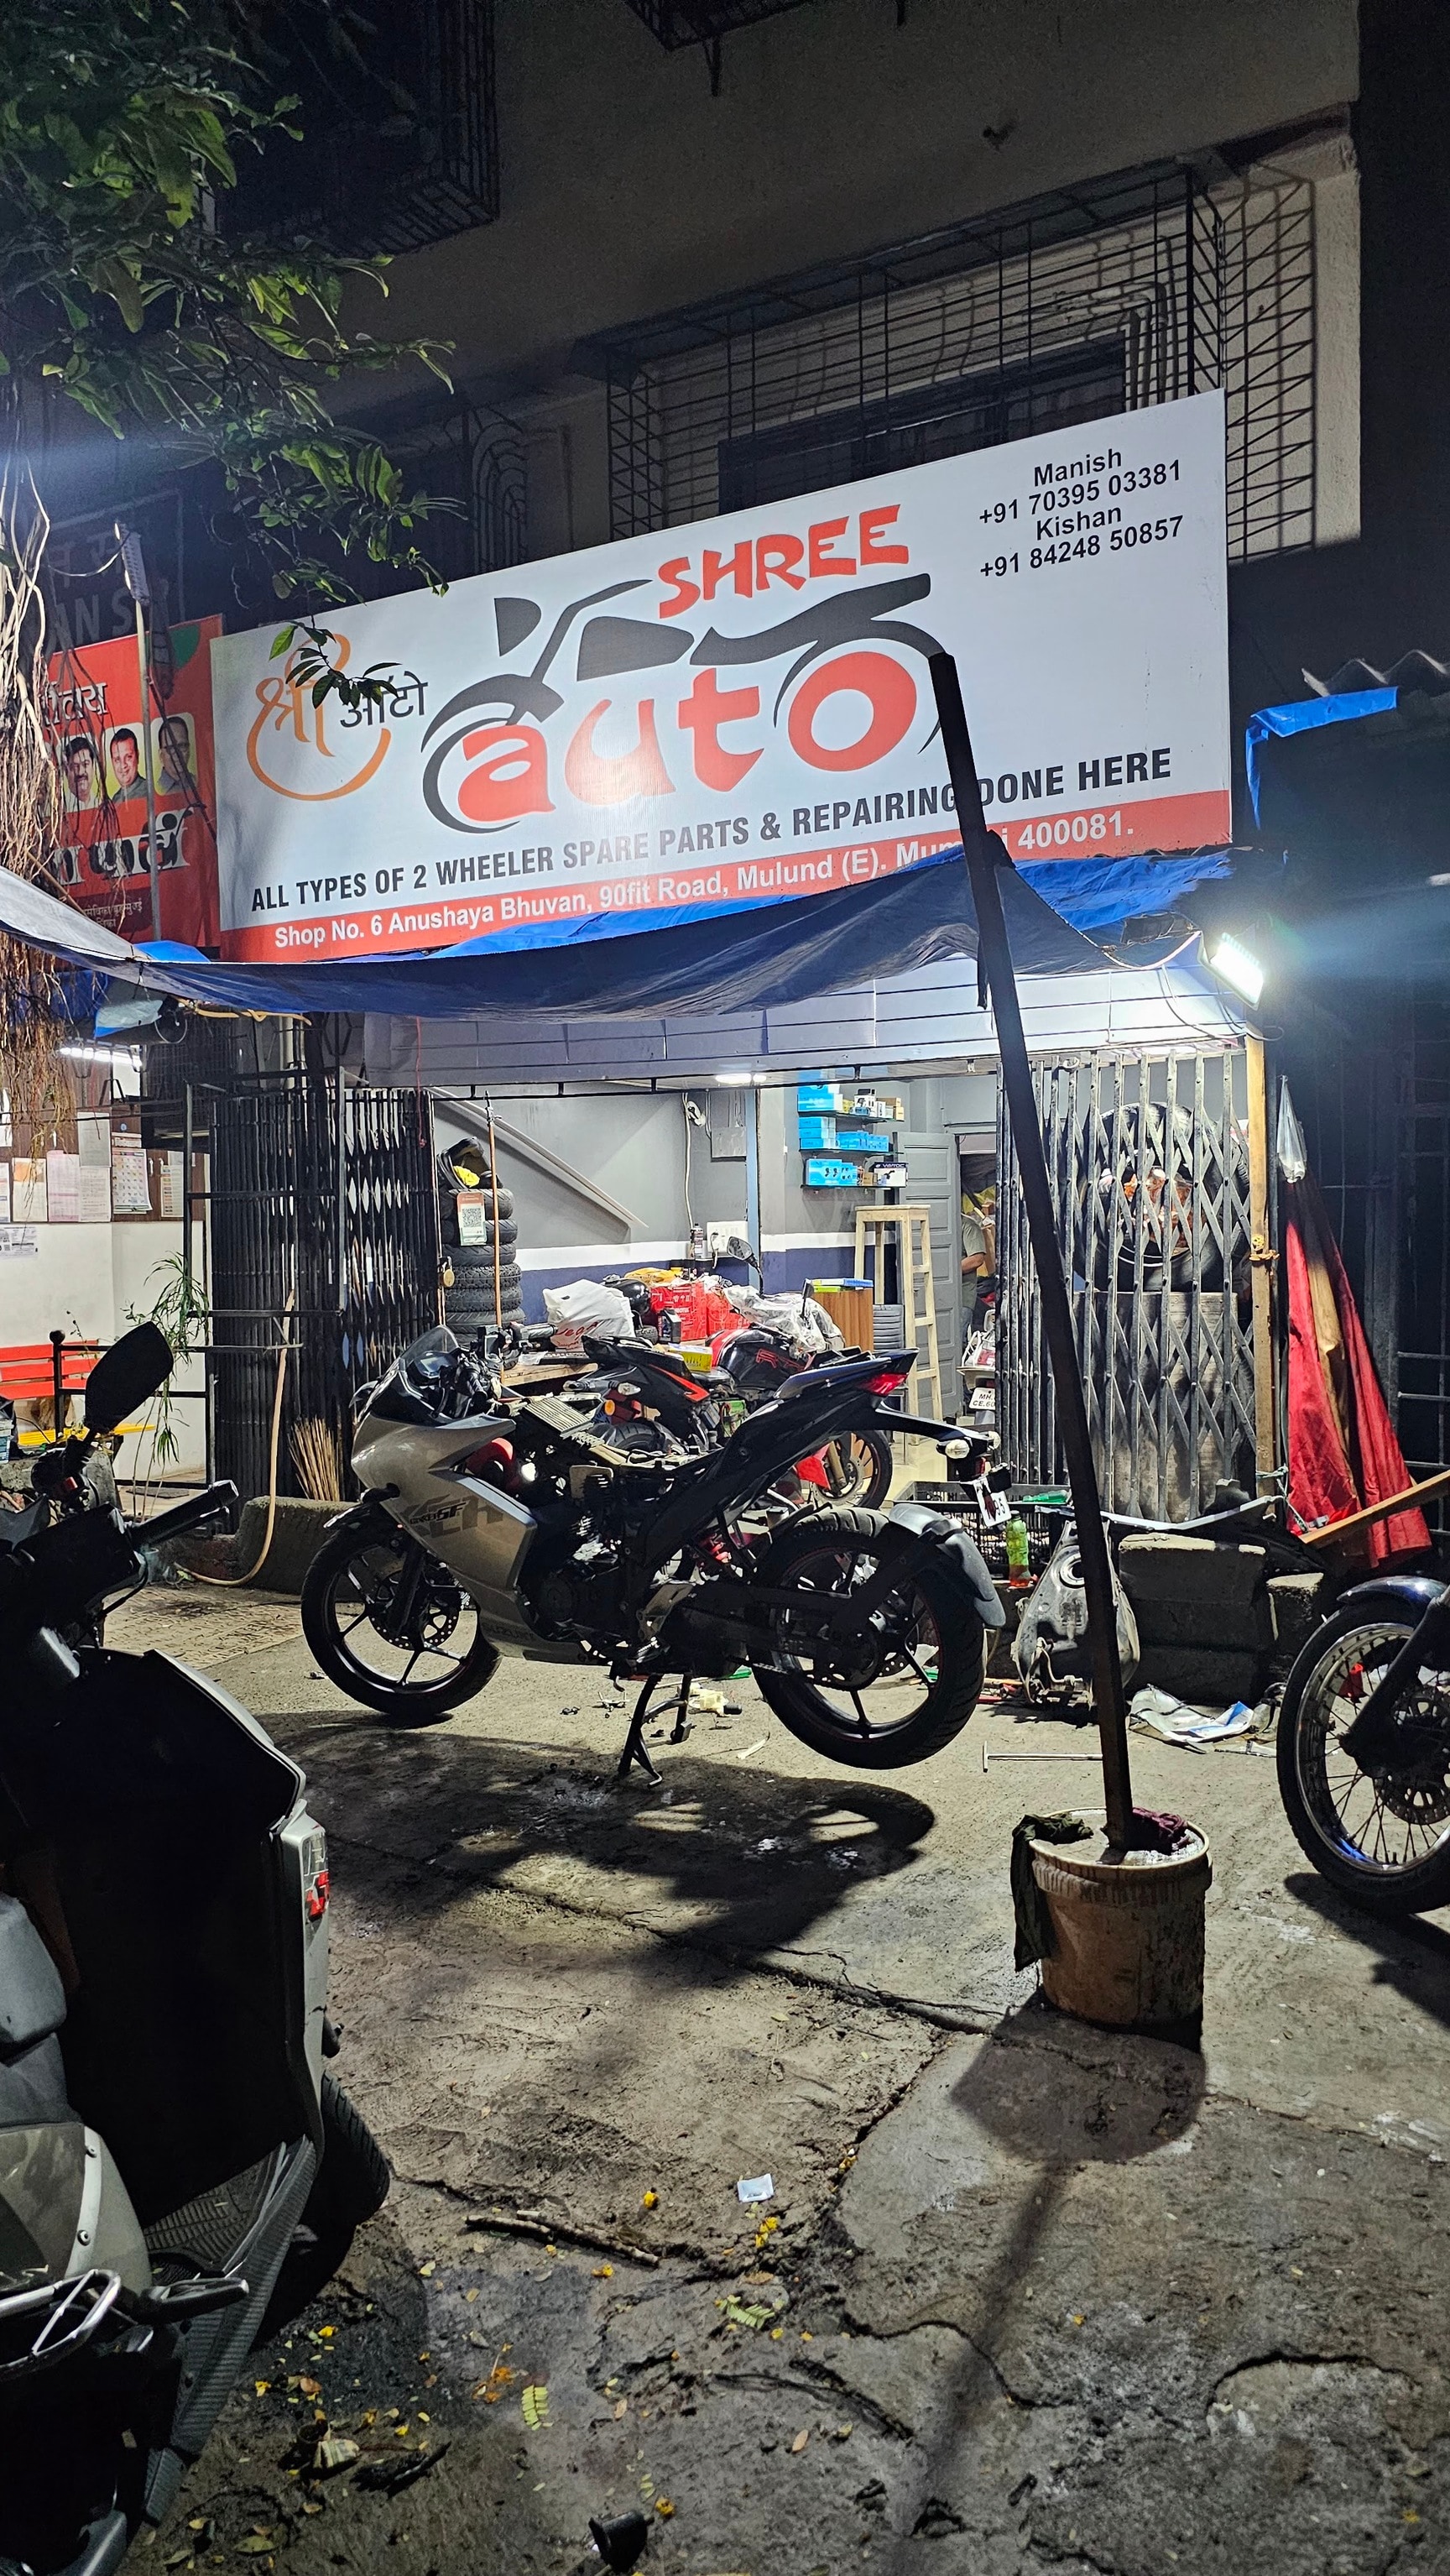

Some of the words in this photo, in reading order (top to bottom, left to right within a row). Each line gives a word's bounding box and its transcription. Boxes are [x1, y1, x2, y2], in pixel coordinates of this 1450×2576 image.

[979, 499, 1018, 524] +91
[1028, 479, 1099, 515] 70395
[1108, 459, 1180, 495] 03381
[1034, 448, 1122, 487] Manish
[657, 504, 909, 619] SHREE
[980, 552, 1019, 577] +91
[1030, 535, 1100, 569] 84248
[1110, 515, 1183, 551] 50857
[1036, 507, 1122, 541] Kishan
[458, 651, 916, 822] auto
[252, 885, 289, 912] ALL
[296, 873, 366, 905] TYPES
[375, 868, 404, 894] OF
[414, 865, 426, 889] 2
[436, 847, 554, 886] WHEELER
[563, 833, 649, 869] SPARE
[660, 818, 748, 856] PARTS
[760, 813, 781, 840] &
[793, 784, 957, 836] REPAIRING
[978, 765, 1063, 806] DONE
[1078, 748, 1171, 791] HERE
[274, 923, 325, 948] Shop
[331, 921, 364, 941] No.
[370, 915, 383, 936] 6
[389, 902, 493, 933] Anushaya
[501, 893, 592, 921] Bhuvan,
[599, 880, 650, 908] 90fit
[658, 875, 728, 902] Road,
[738, 854, 832, 891] Mulund
[1017, 810, 1134, 850] 400081.
